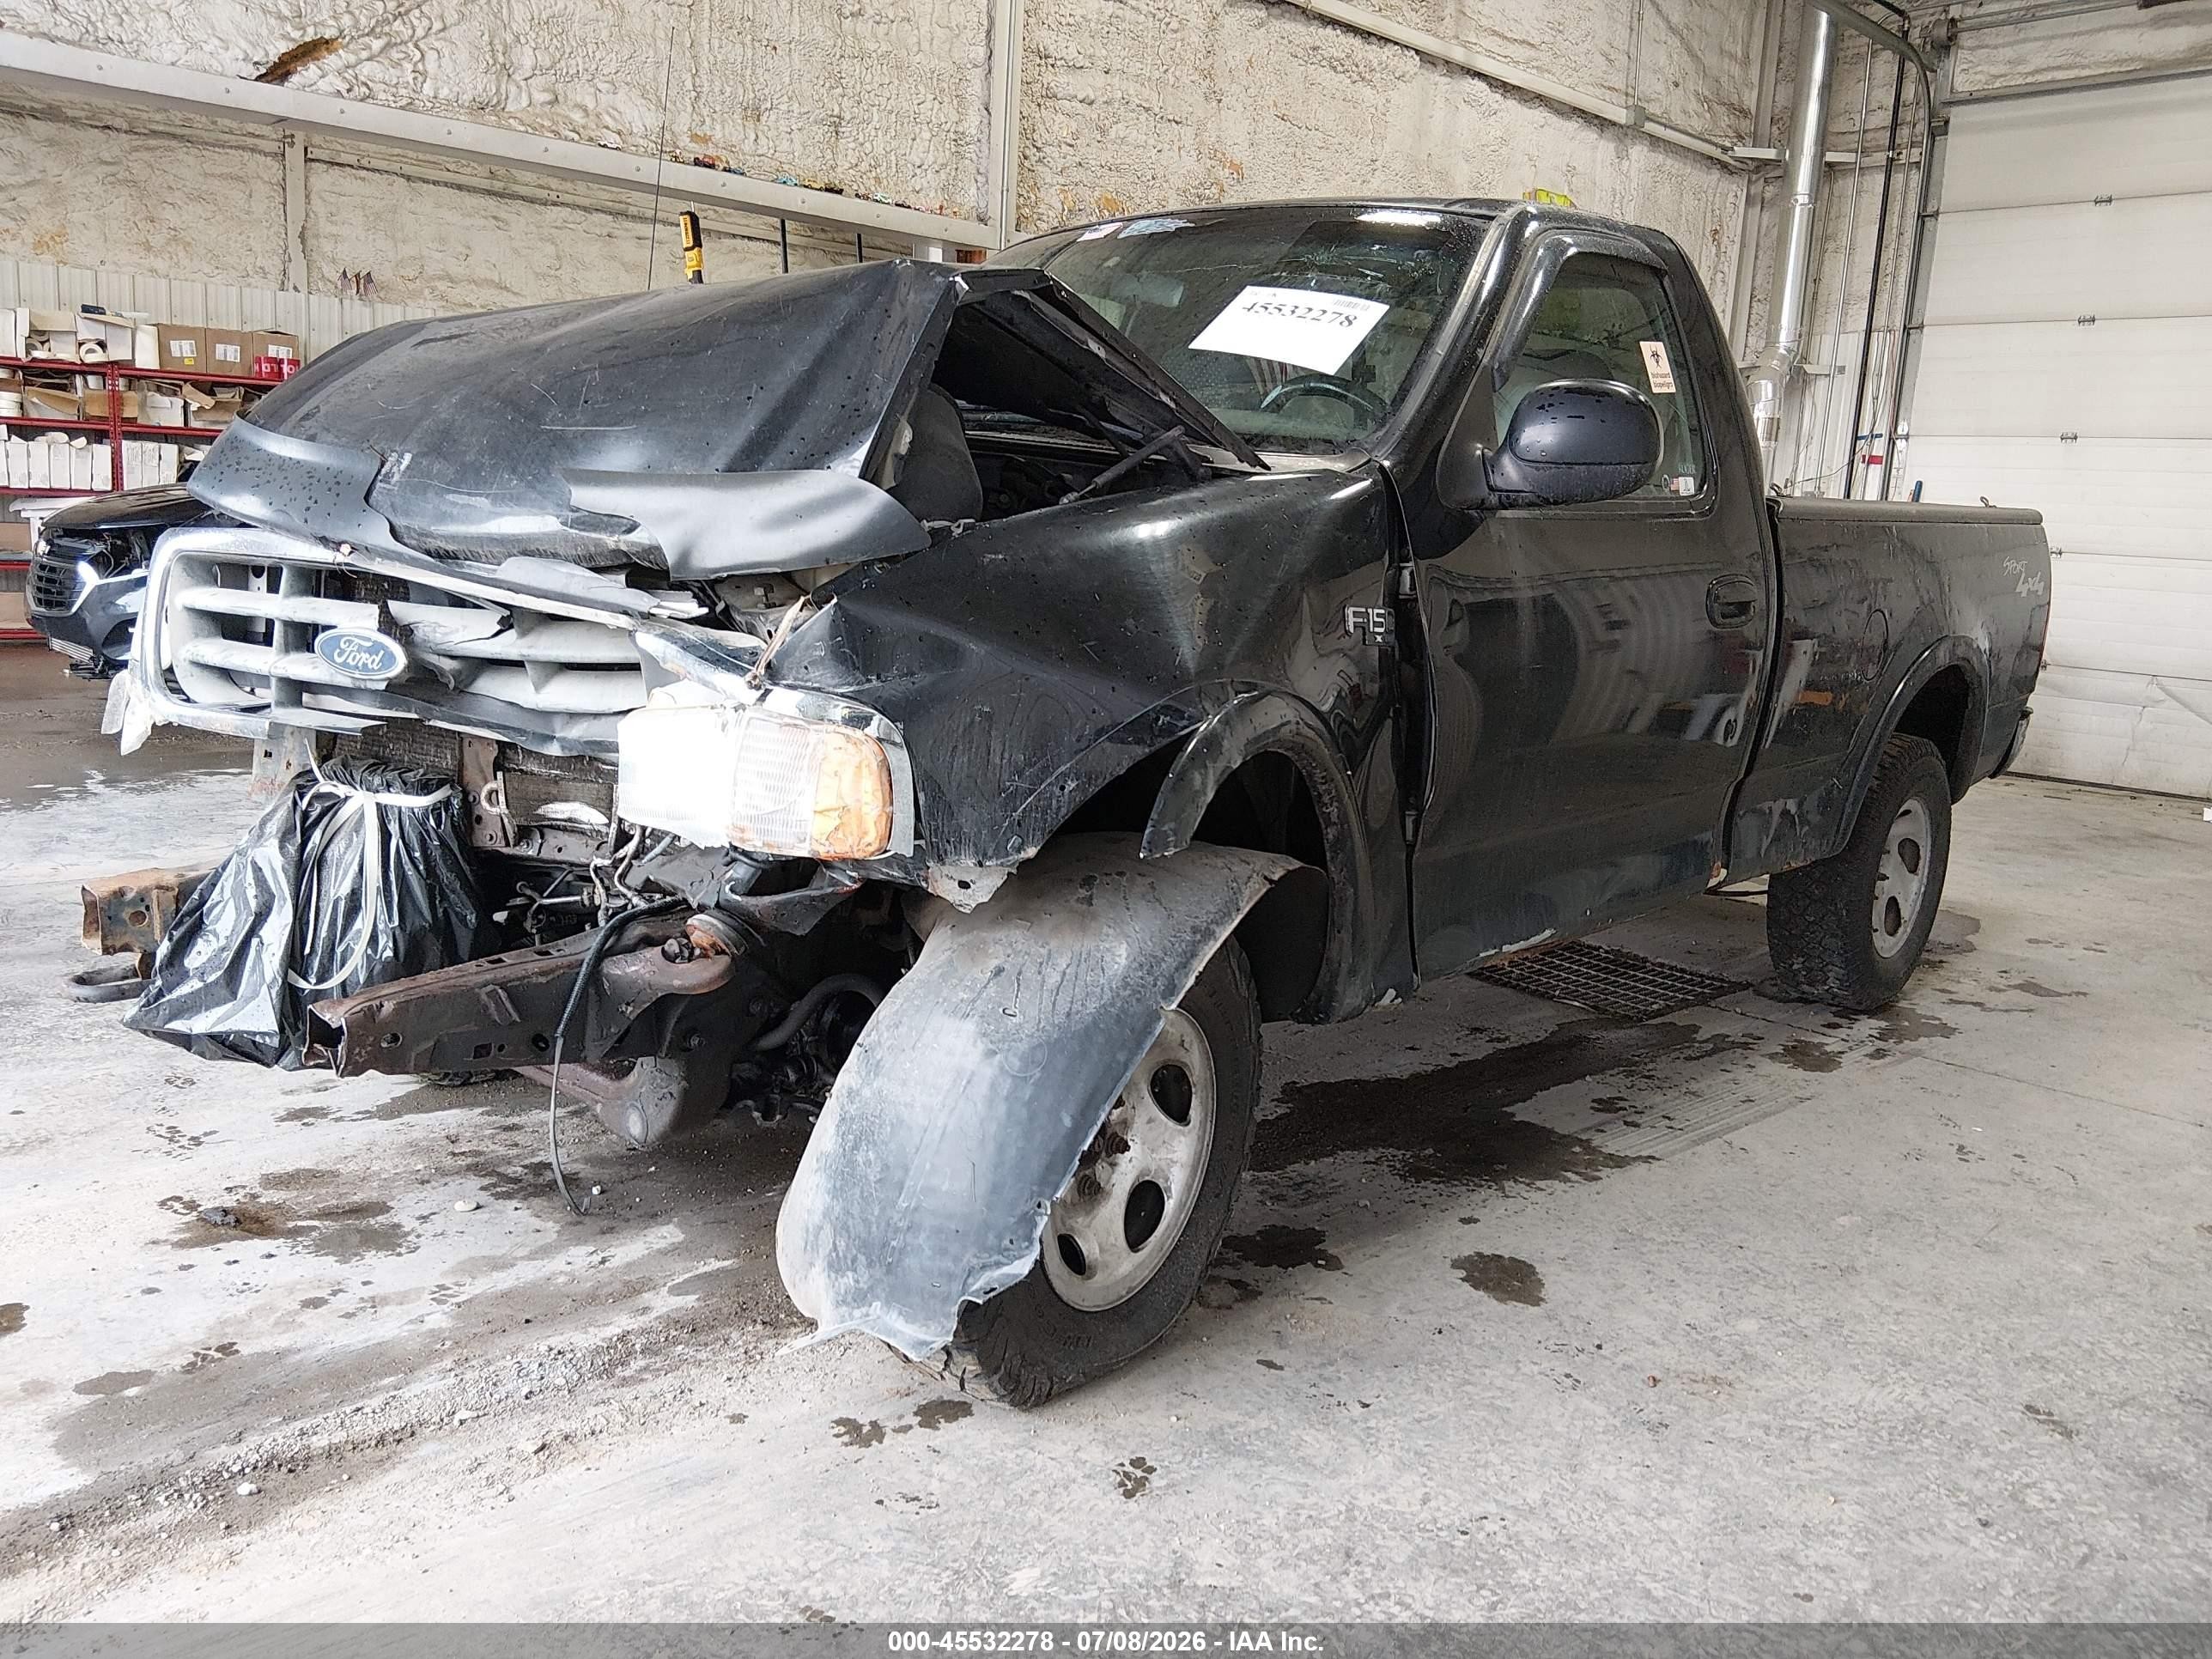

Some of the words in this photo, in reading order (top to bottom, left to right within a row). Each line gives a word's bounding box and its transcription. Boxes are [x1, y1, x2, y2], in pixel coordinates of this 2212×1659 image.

[1242, 301, 1358, 328] 45532278
[2003, 556, 2028, 576] SPORT
[333, 636, 385, 670] Ford
